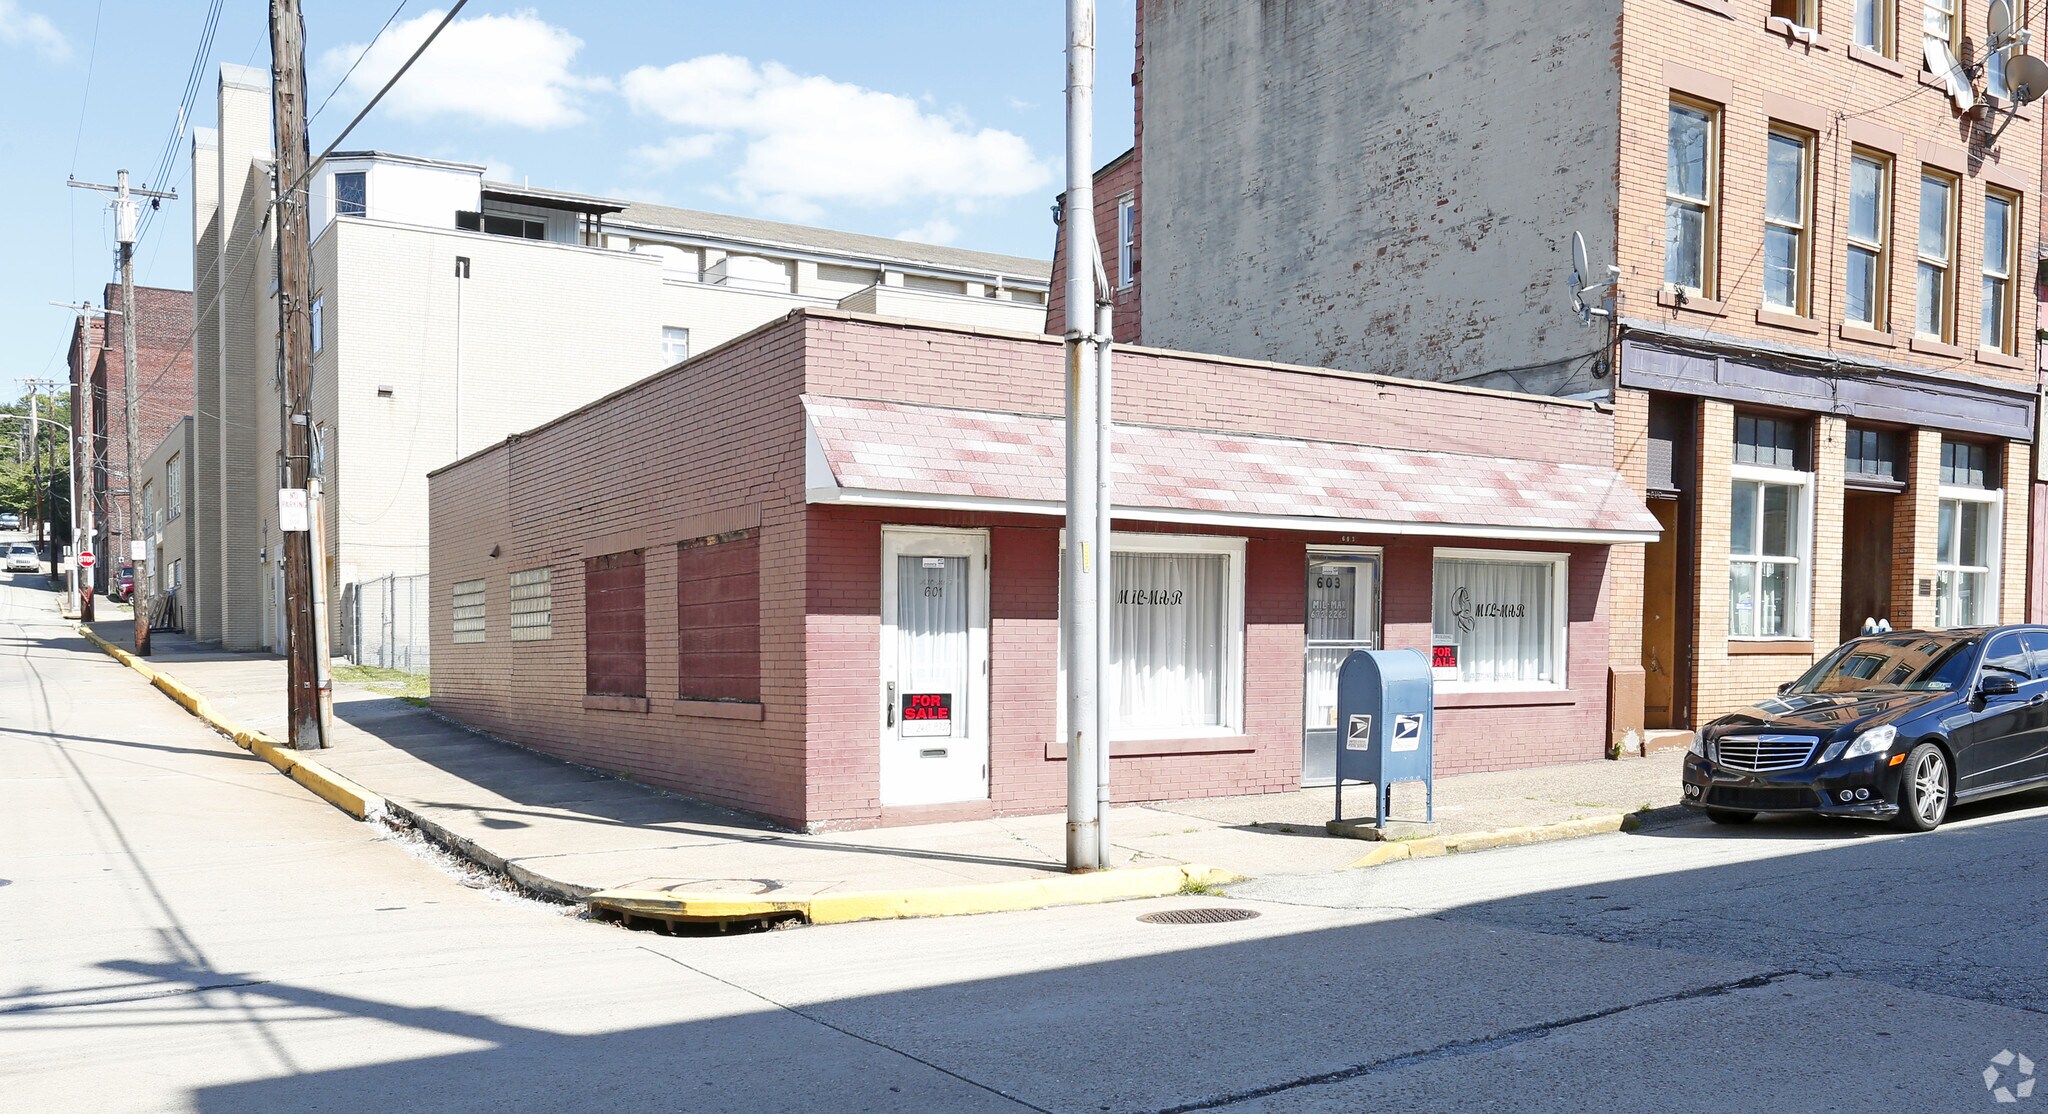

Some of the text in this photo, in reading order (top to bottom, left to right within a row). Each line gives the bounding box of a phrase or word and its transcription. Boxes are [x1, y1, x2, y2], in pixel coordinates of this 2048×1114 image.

[290, 491, 298, 499] NO
[1316, 576, 1341, 589] 603
[924, 586, 943, 597] 601
[1117, 588, 1183, 606] MIL-MAR
[1312, 600, 1346, 609] MIL-MAR
[1475, 603, 1525, 618] MIL-MAR
[1432, 646, 1451, 657] FOR
[911, 694, 942, 707] FOR
[904, 707, 949, 720] SALE
